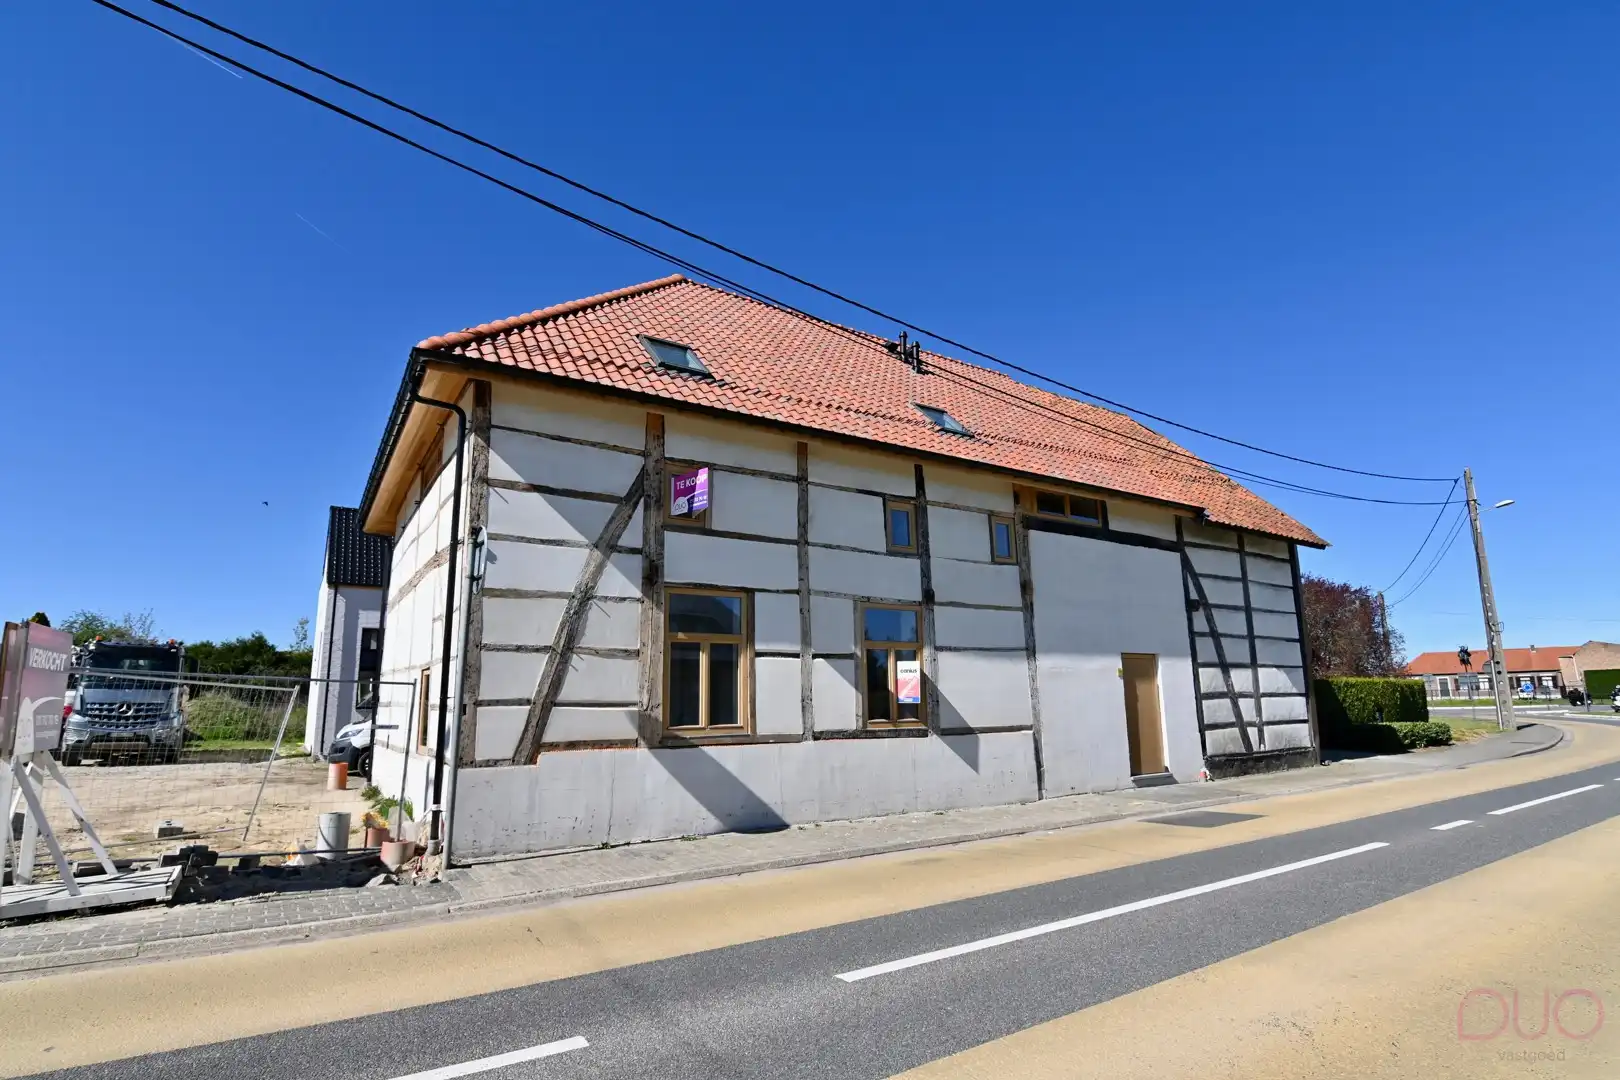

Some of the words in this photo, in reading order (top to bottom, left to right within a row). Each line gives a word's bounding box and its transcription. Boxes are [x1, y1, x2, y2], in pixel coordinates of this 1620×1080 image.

[676, 480, 685, 490] TE
[686, 474, 706, 488] KOOP
[29, 647, 68, 672] VERKOCHT
